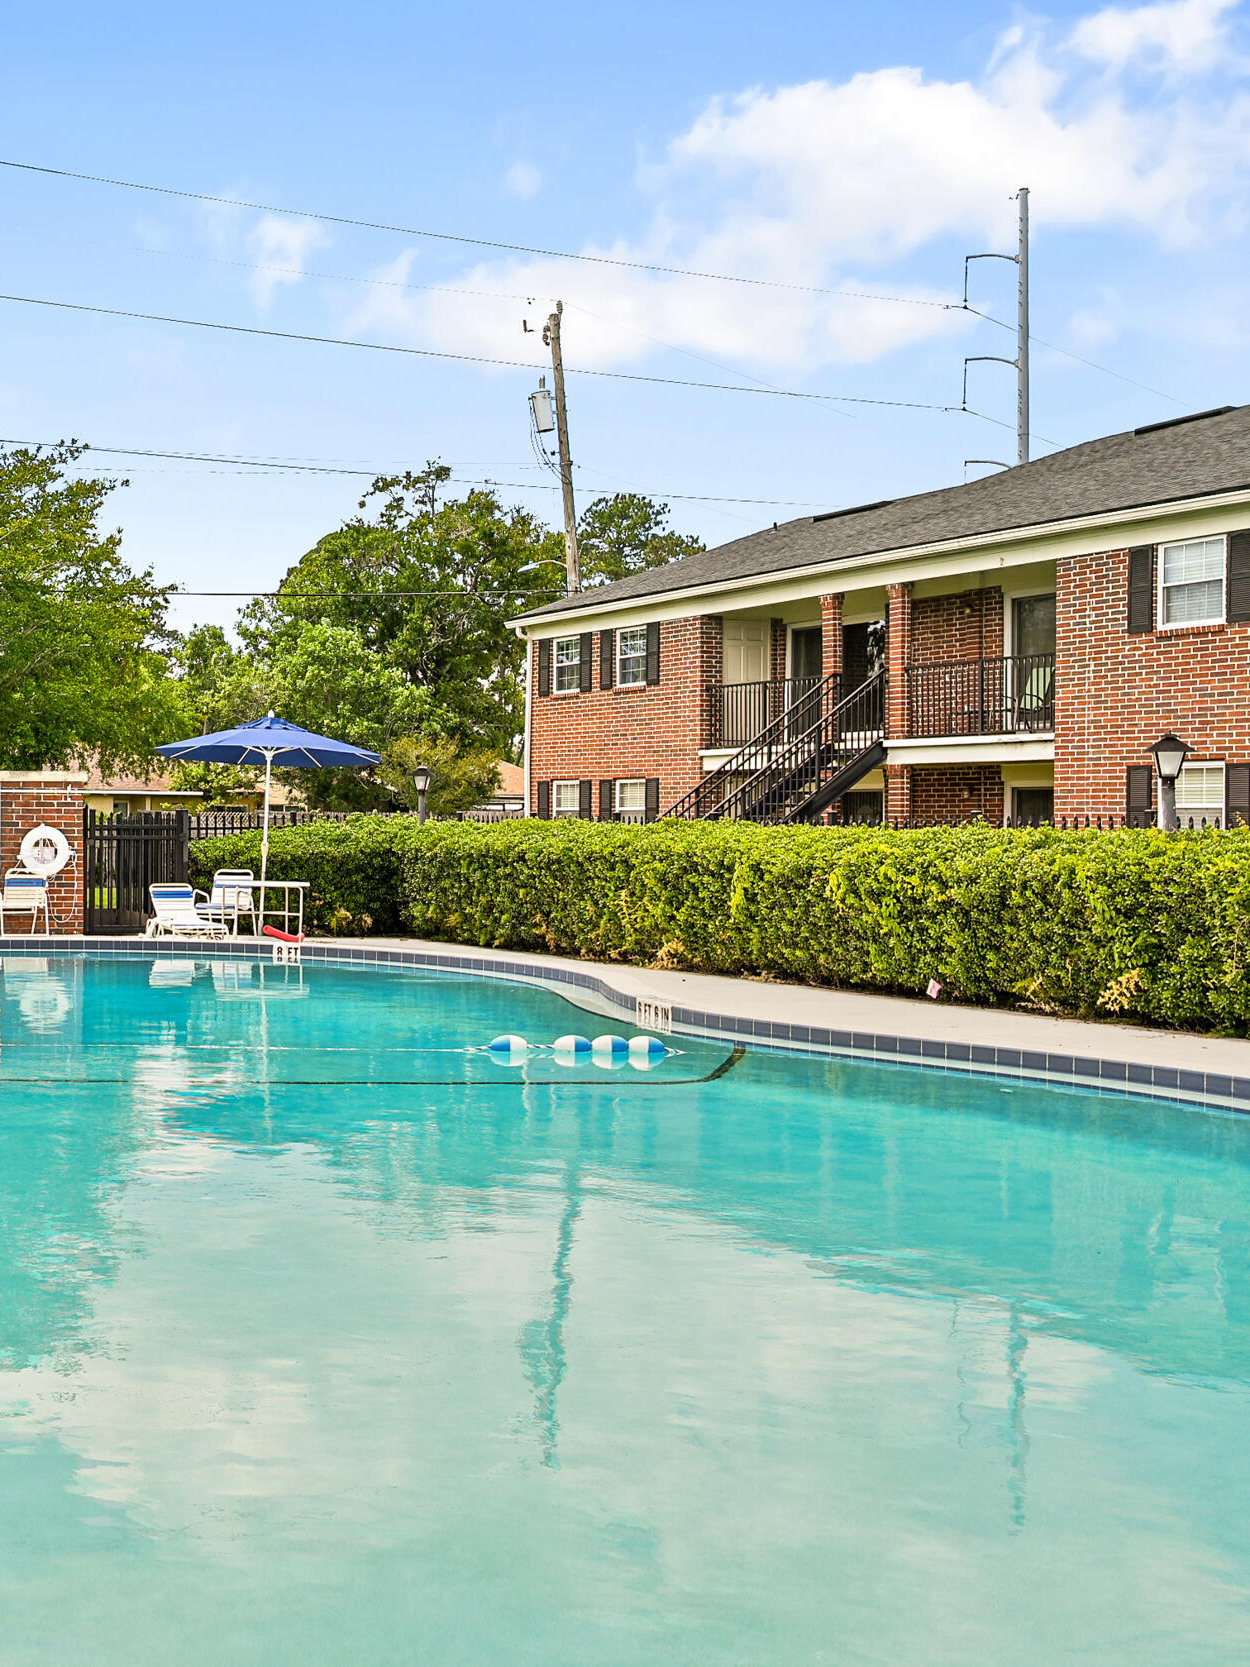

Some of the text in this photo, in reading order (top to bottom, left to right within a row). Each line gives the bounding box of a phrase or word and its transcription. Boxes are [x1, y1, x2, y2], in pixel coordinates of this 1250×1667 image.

[287, 947, 299, 956] FT
[644, 1003, 652, 1016] FT
[661, 1007, 669, 1021] IN
